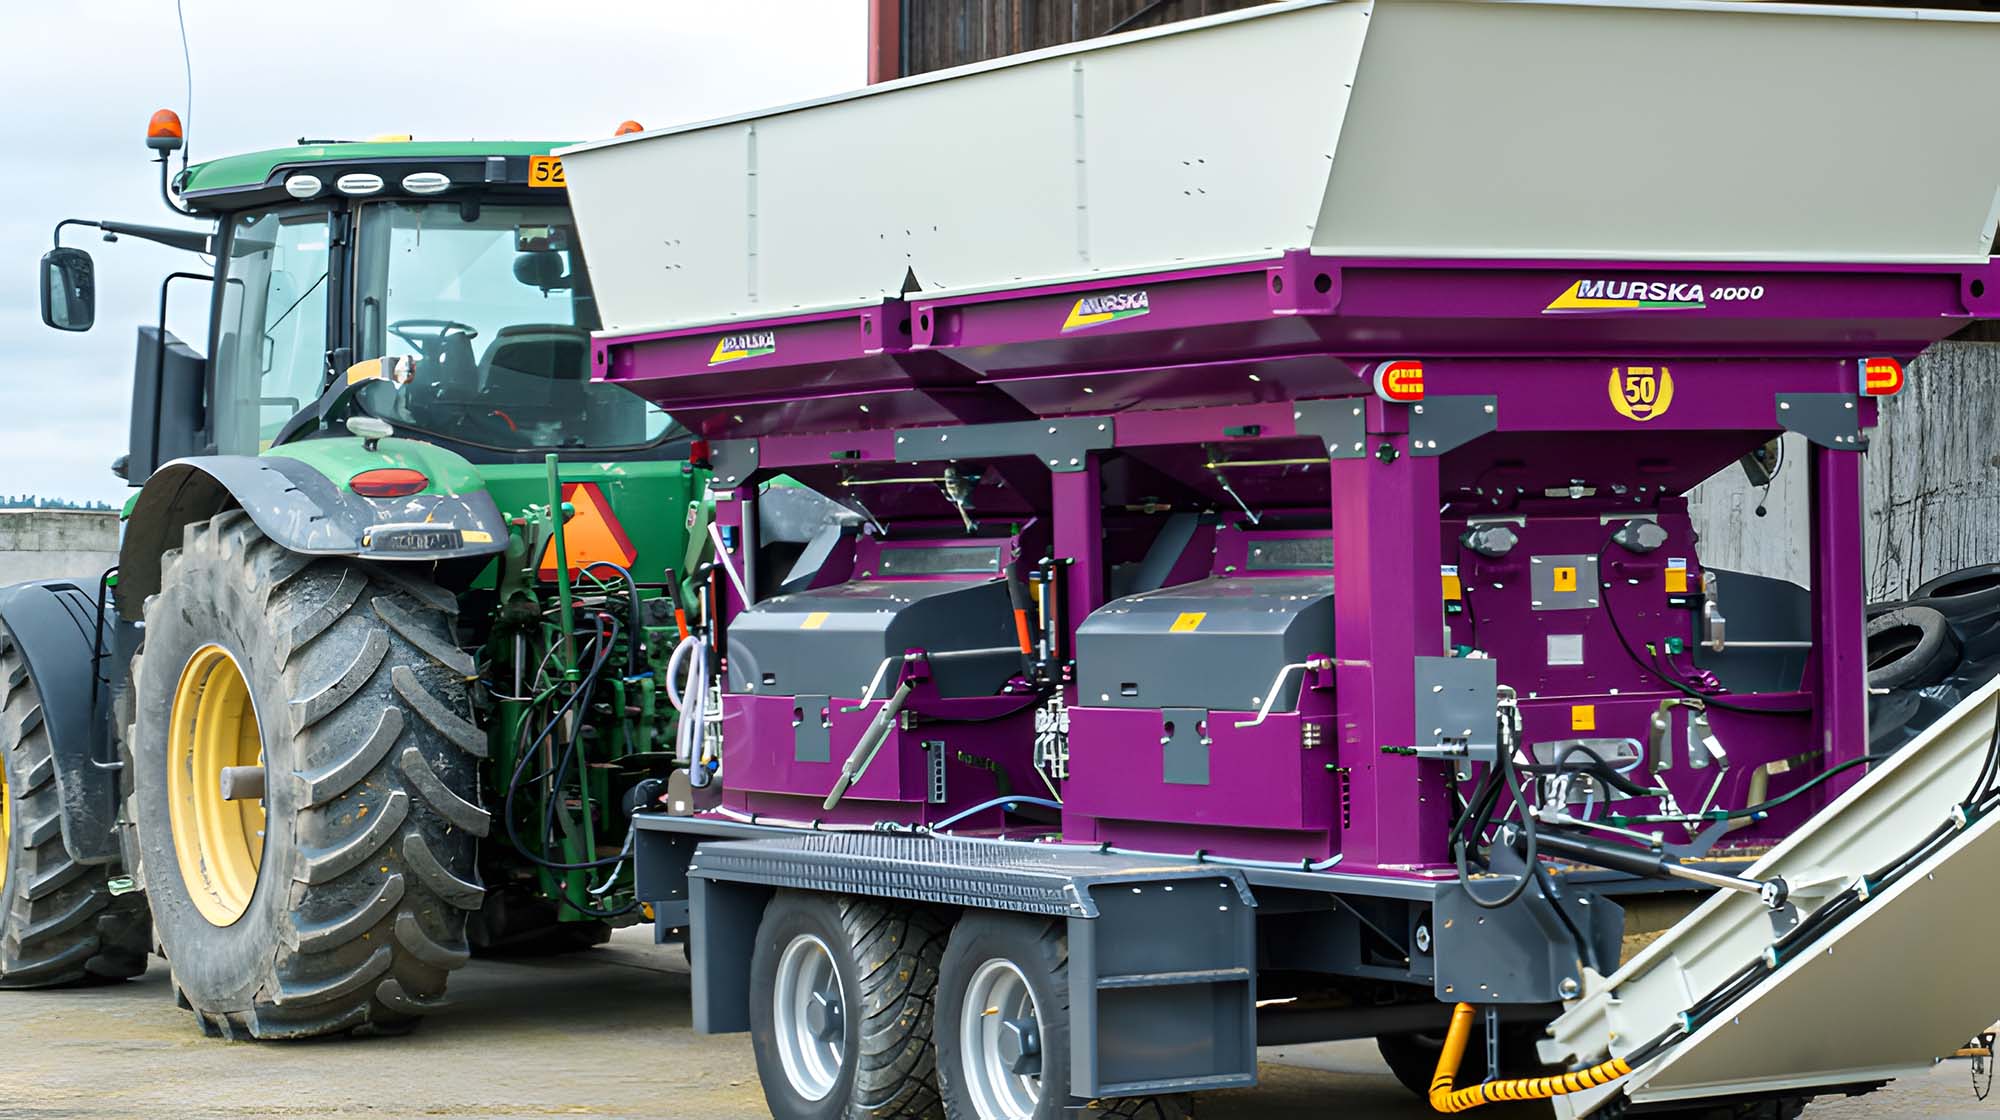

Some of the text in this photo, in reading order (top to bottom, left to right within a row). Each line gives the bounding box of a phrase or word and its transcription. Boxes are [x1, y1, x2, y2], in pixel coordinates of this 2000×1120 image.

[536, 162, 564, 182] 52
[1578, 280, 1764, 302] MURSKA 4000
[1625, 376, 1656, 403] 50
